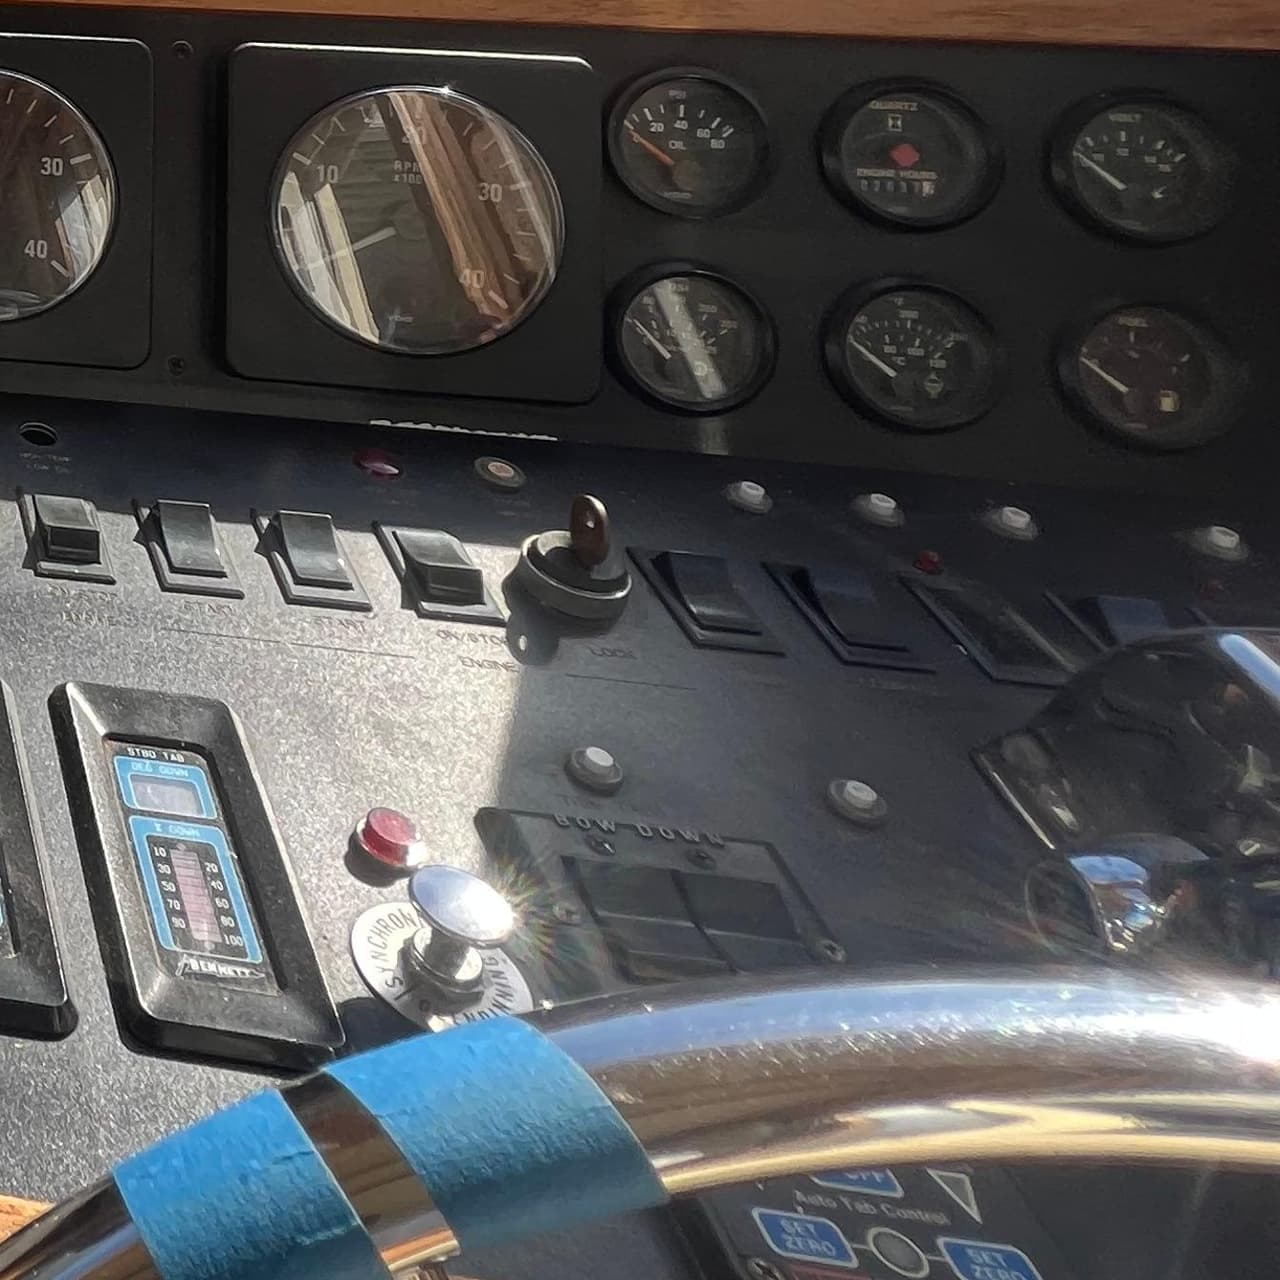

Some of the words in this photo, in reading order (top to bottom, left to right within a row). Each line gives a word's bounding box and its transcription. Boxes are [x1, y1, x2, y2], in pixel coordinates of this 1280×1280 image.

[649, 122, 665, 133] 20
[673, 120, 689, 130] 40
[668, 139, 688, 151] OIL
[41, 156, 64, 176] 30
[316, 164, 339, 184] 10
[478, 182, 503, 203] 30
[24, 239, 48, 259] 40
[458, 269, 486, 289] 40
[436, 629, 506, 644] ON/STO
[162, 750, 185, 763] TAB
[636, 823, 726, 848] DOWN
[152, 846, 167, 858] 10
[156, 863, 171, 875] 30
[204, 861, 219, 873] 20
[160, 880, 176, 892] 50
[166, 898, 181, 911] 70
[214, 896, 230, 910] 60
[171, 916, 186, 929] 90
[223, 933, 244, 947] 100
[367, 907, 425, 990] SYNCHRON
[793, 1188, 838, 1209] Auto
[839, 1195, 878, 1215] Tab
[880, 1202, 952, 1226] Control
[780, 1220, 817, 1235] SET
[784, 1234, 836, 1257] ZERO
[965, 1247, 1008, 1268] SET
